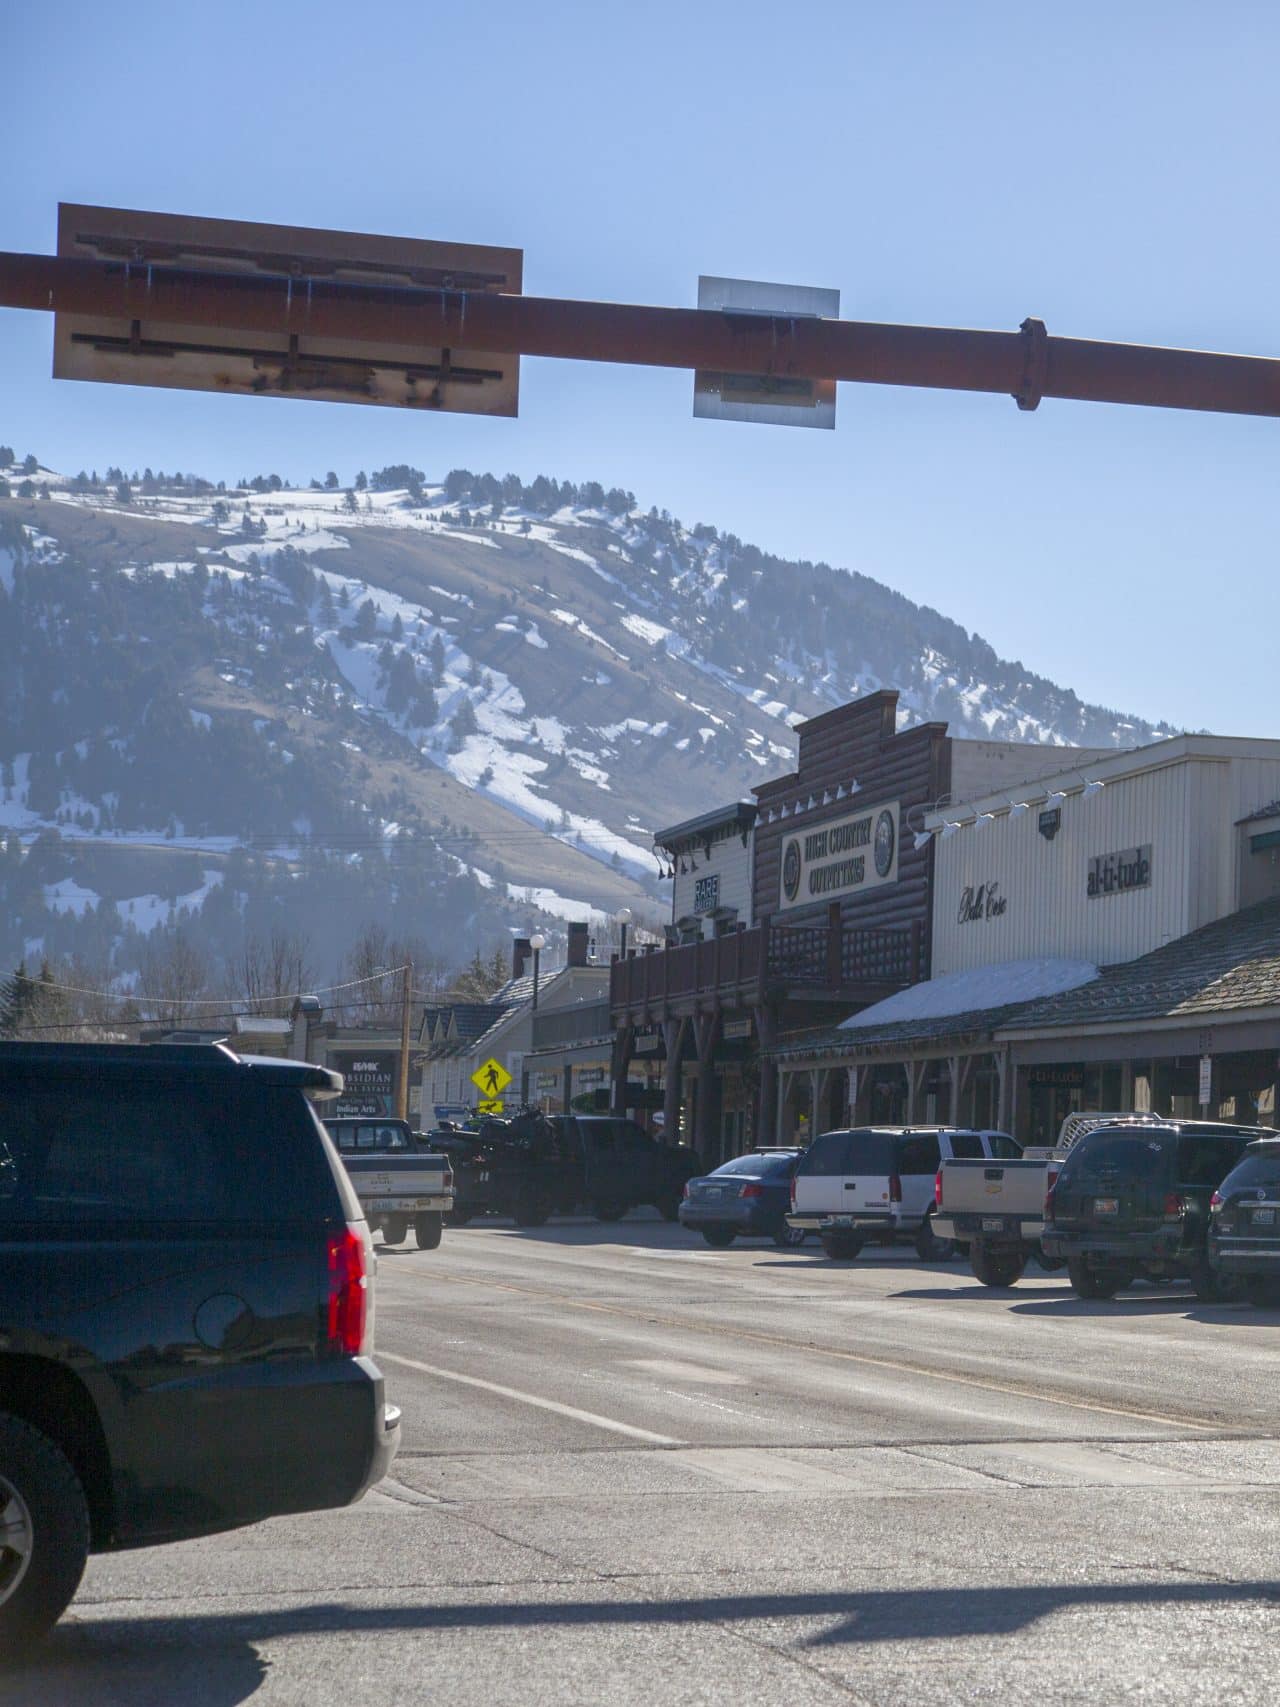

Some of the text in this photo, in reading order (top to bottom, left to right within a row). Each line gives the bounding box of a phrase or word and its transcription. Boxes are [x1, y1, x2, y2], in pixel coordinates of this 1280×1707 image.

[805, 816, 873, 862] HIGH COUNTRY
[336, 1104, 376, 1113] Indian Arts
